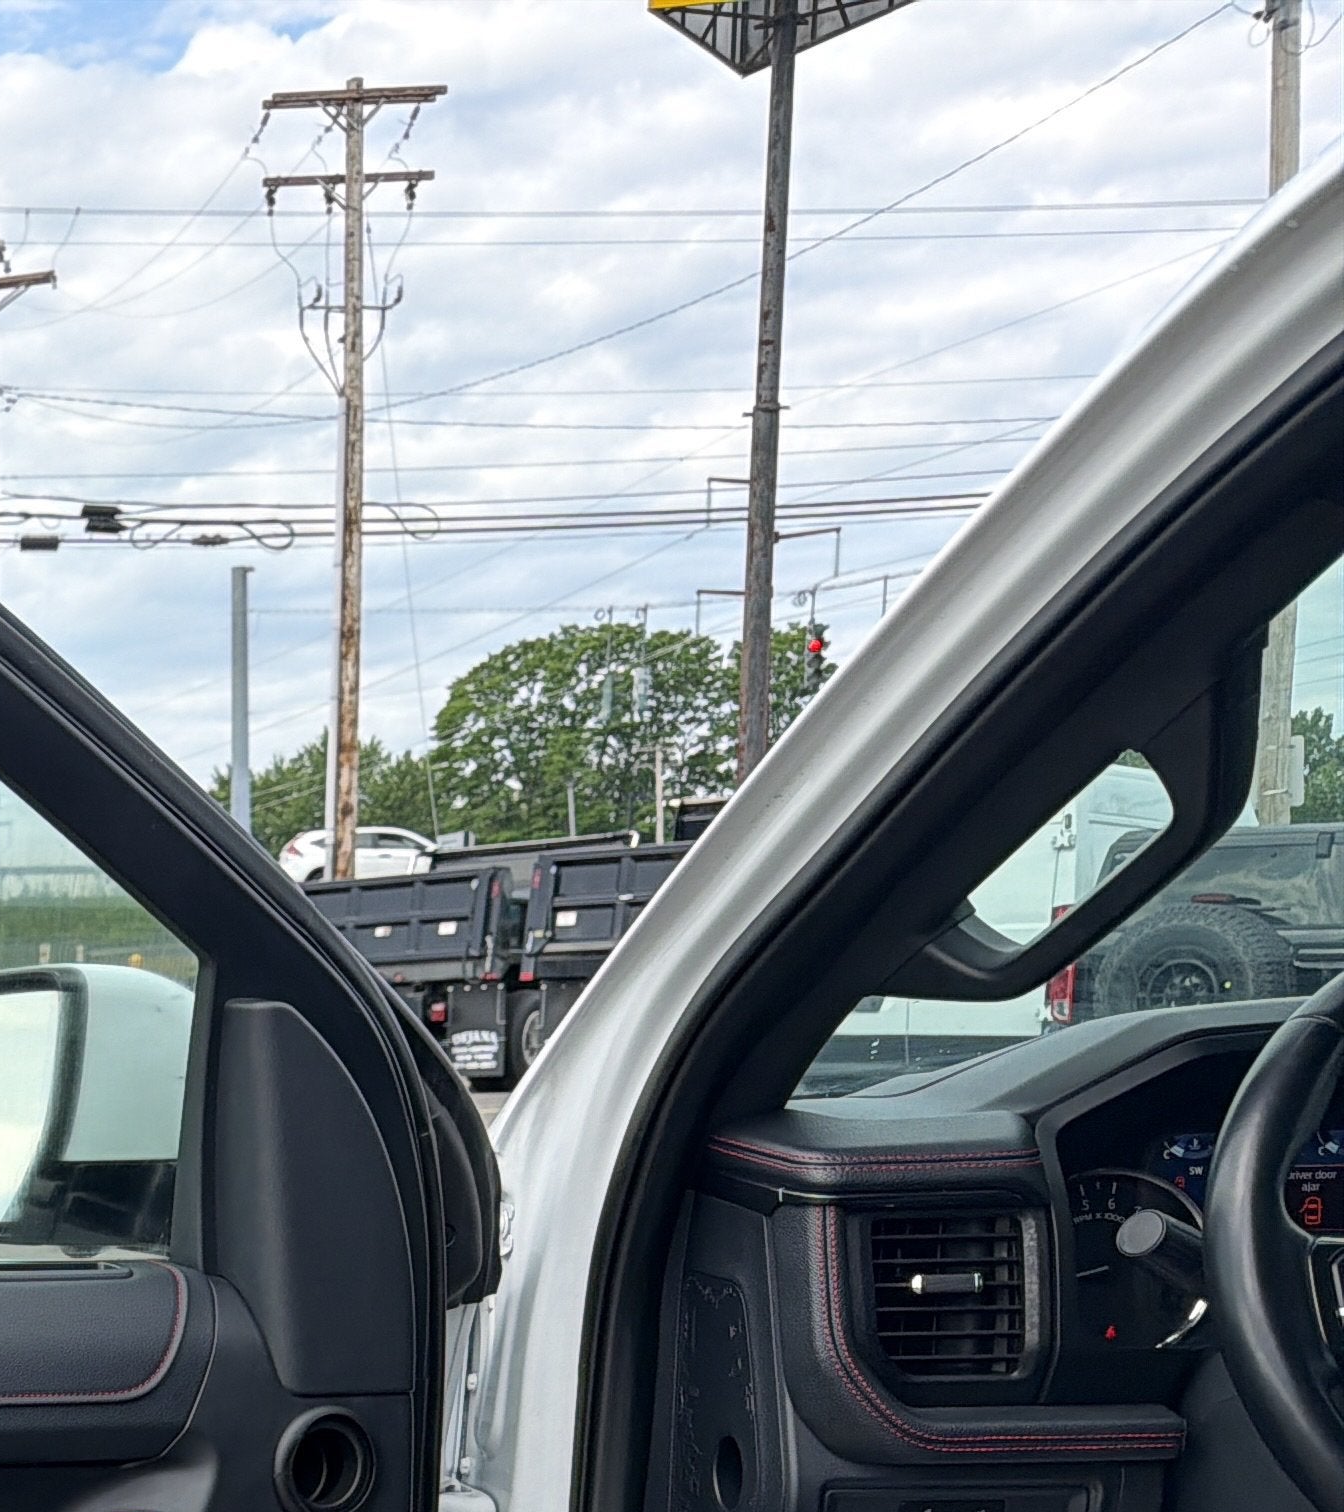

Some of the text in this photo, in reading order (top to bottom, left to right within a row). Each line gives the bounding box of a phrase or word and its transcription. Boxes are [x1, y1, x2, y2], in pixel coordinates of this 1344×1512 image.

[1188, 1166, 1204, 1176] SW
[1315, 1169, 1338, 1180] door
[1301, 1181, 1321, 1193] ajar
[1082, 1199, 1090, 1211] 5
[1108, 1198, 1116, 1210] 6
